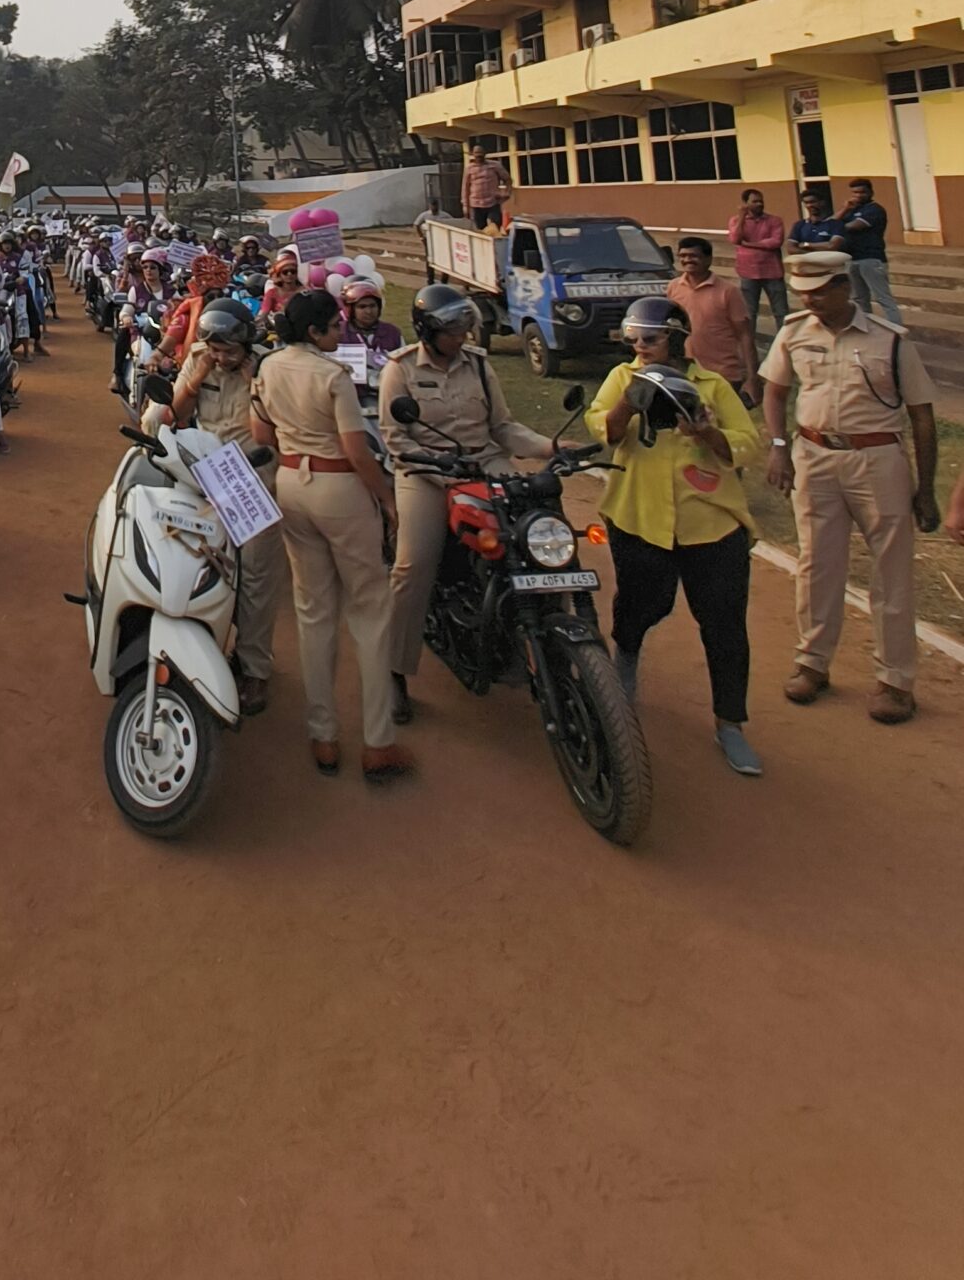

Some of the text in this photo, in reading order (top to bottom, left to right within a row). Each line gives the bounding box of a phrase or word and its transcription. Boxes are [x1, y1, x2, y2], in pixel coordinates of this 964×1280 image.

[571, 284, 668, 296] TRAFFIC POLIC
[218, 460, 236, 482] THE
[233, 482, 260, 522] WHEEL
[228, 458, 252, 488] WOMAN
[250, 488, 273, 521] BEHIND
[526, 578, 537, 586] AP
[572, 574, 596, 584] 4459
